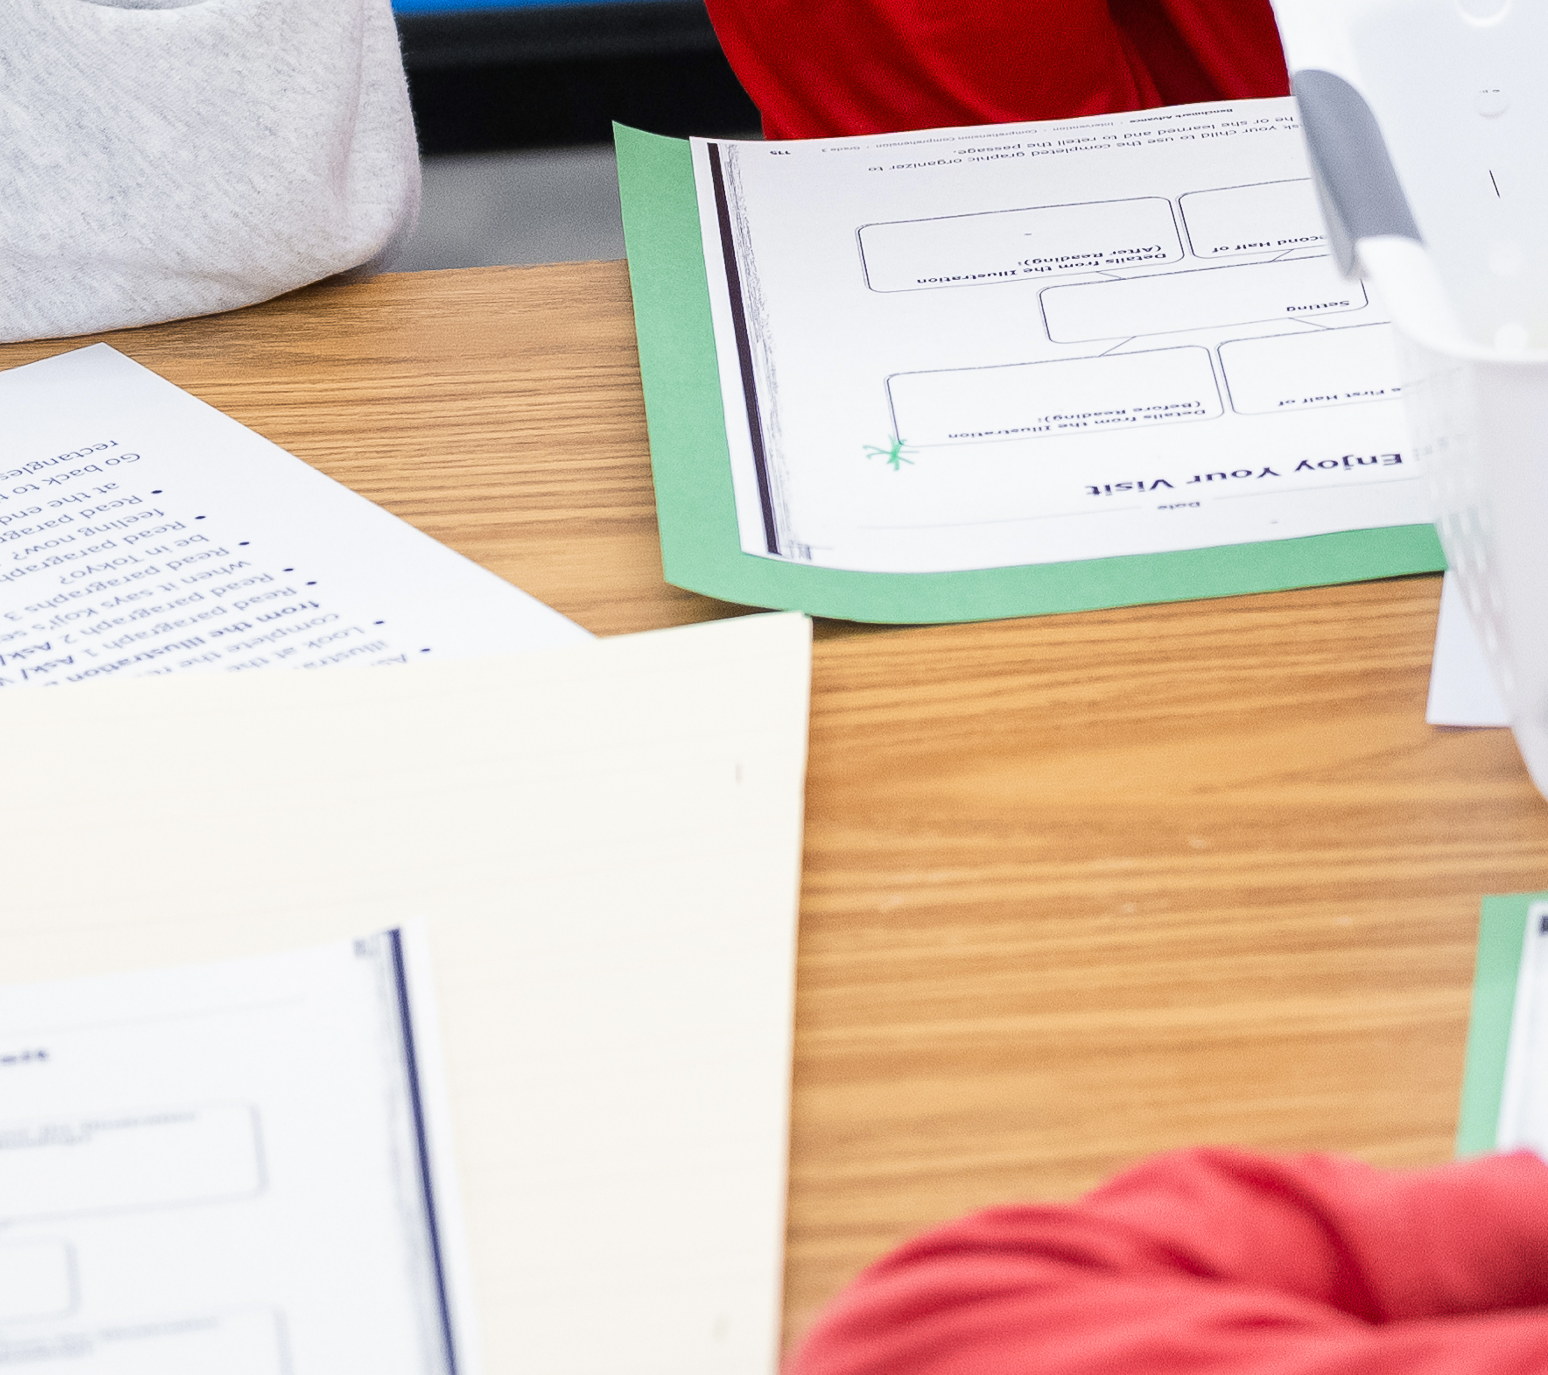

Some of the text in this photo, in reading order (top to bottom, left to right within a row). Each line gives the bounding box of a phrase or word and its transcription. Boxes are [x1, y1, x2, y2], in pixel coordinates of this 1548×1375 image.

[952, 115, 1295, 156] he or she learned and to retell the passage.
[1178, 133, 1196, 141] to
[1199, 128, 1238, 139] child
[1241, 124, 1278, 135] your
[1029, 142, 1112, 157] completed
[1115, 139, 1143, 148] the
[1146, 136, 1175, 145] use
[888, 157, 963, 171] organizer
[967, 150, 1026, 163] graphic
[1017, 243, 1163, 267] (After Reading):
[1211, 245, 1230, 254] of
[1233, 240, 1272, 251] Half
[915, 252, 1167, 284] Details from the Illustration
[1285, 299, 1350, 313] Setting
[1277, 398, 1297, 407] of
[1301, 393, 1339, 404] Half
[1345, 388, 1386, 399] First
[1037, 399, 1202, 424] (Before Reading):
[947, 408, 1207, 439] Details from the Illustration
[103, 452, 142, 467] Go
[40, 463, 104, 486] back
[1084, 452, 1403, 497] Enjoy Your Visit
[11, 482, 41, 495] to
[91, 481, 120, 495] at
[46, 491, 92, 508] the
[77, 493, 144, 520] Read
[75, 507, 166, 538] feeling
[121, 519, 187, 546] Read
[11, 533, 77, 561] now?
[58, 532, 211, 585] be in Tokyo?
[164, 545, 231, 572] Read
[179, 559, 252, 585] when
[23, 564, 162, 613] paragraphs
[157, 581, 179, 593] it
[208, 571, 276, 599] Read
[99, 589, 154, 609] says
[231, 585, 298, 612] Read
[2, 611, 23, 622] 3
[78, 590, 206, 636] paragraph
[254, 599, 321, 623] from
[101, 604, 229, 650] paragraph
[209, 620, 254, 638] the
[62, 632, 77, 645] 2
[65, 635, 207, 683] Illustration
[82, 647, 99, 658] 1
[19, 653, 76, 681] Ask/
